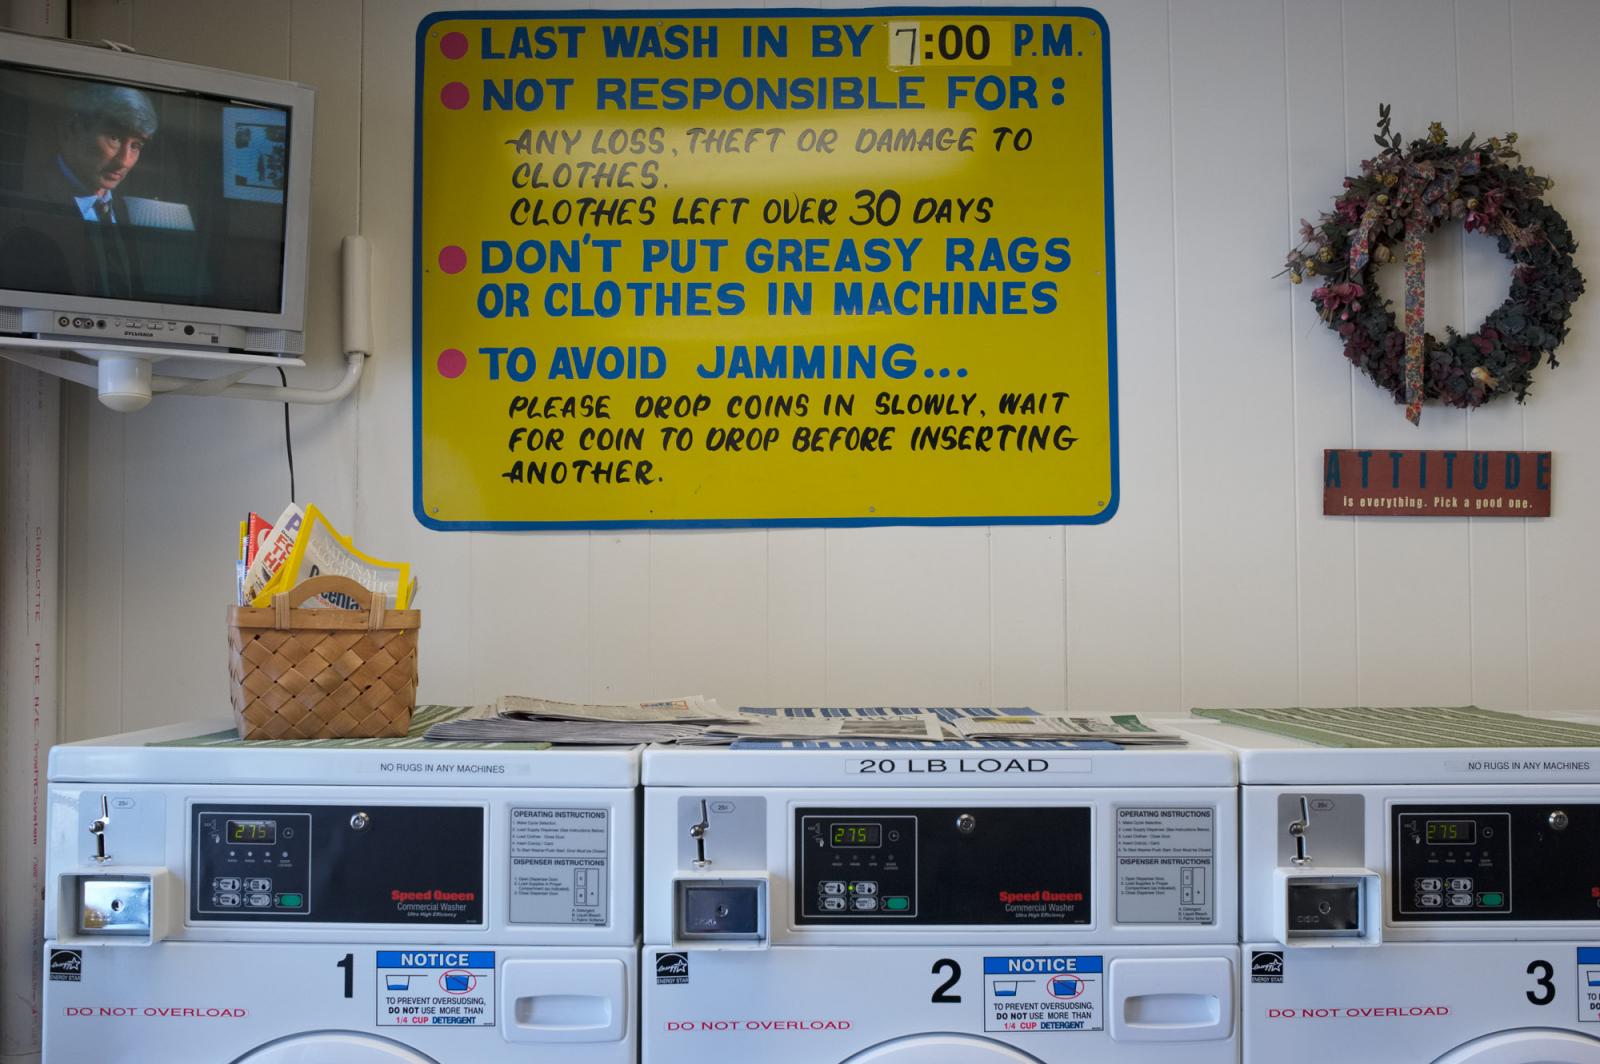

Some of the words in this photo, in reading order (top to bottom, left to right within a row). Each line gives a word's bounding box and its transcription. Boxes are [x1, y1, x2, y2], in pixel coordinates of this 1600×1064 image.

[481, 26, 585, 59] LAST
[603, 25, 717, 59] WASH
[743, 26, 787, 57] IN
[812, 25, 873, 57] BY
[1015, 24, 1082, 56] P.M.
[483, 79, 574, 111] NOT
[597, 76, 924, 110] RESPONSIBLE
[506, 128, 581, 154] ANY
[592, 128, 679, 158] LOSS,
[687, 126, 780, 154] THEFT
[798, 129, 837, 153] OR
[856, 127, 977, 153] DAMAGE
[993, 127, 1032, 151] TO
[512, 160, 669, 189] CLOTHES.
[510, 197, 656, 226] CLOTHES
[673, 198, 749, 224] LEFT
[763, 198, 837, 225] OVER
[849, 190, 901, 226] 30
[913, 197, 993, 223] DAYS
[482, 234, 621, 273] DON'T
[643, 240, 728, 273] PUT
[746, 238, 922, 273] GREASY
[946, 237, 1071, 272] RAGS
[477, 283, 529, 318] OR
[544, 281, 745, 317] CLOTHES
[768, 283, 812, 315] IN
[834, 281, 1057, 315] MACHINES
[479, 347, 536, 382] TO
[549, 346, 666, 379] AVOID
[697, 344, 967, 379] JAMMING...
[509, 395, 610, 418] PLEASE
[635, 395, 711, 419] DROP
[727, 394, 809, 419] COINS
[824, 394, 854, 416] IN
[876, 392, 986, 417] SLOWLY,
[999, 392, 1069, 414] WAIT
[509, 428, 564, 451] FOR
[579, 428, 644, 450] COIN
[661, 427, 693, 451] TO
[706, 428, 779, 451] DROP
[792, 427, 895, 452] BEFORE
[911, 425, 1080, 452] INSERTING
[502, 460, 664, 484] ANOTHER.
[1326, 451, 1549, 490] ATTITUDE
[1343, 496, 1354, 507] is
[1360, 496, 1427, 509] everything.
[1434, 496, 1458, 508] Pick
[1464, 498, 1470, 508] a
[1475, 496, 1502, 510] good
[1509, 498, 1533, 509] one.
[380, 763, 394, 772] NO
[396, 763, 423, 773] RUGS
[425, 764, 433, 773] IN
[436, 764, 455, 773] ANY
[456, 764, 505, 774] MACHINES
[859, 759, 895, 774] 20
[908, 759, 948, 773] LB
[959, 758, 1050, 773] LOAD
[1468, 761, 1482, 770] NO
[1483, 761, 1510, 770] RUGS
[1511, 761, 1521, 770] IN
[1522, 761, 1541, 770] ANY
[1542, 761, 1590, 770] MACHINES
[514, 810, 553, 818] OPERATING
[555, 811, 606, 819] INSTRUCTIONS
[1120, 810, 1159, 818] OPERATING
[1160, 810, 1211, 818] INSTRUCTIONS
[391, 889, 432, 902] Speed
[434, 890, 475, 901] Queen
[999, 891, 1040, 903] Speed
[1042, 891, 1083, 902] Queen
[397, 902, 439, 911] Commercial
[440, 902, 467, 911] Washer
[1005, 903, 1047, 912] Commercial
[1048, 903, 1074, 912] Washer
[401, 953, 469, 966] NOTICE
[1008, 958, 1077, 972] NOTICE
[336, 953, 354, 999] 1
[931, 958, 962, 1004] 2
[1526, 960, 1556, 1006] 3
[386, 997, 395, 1005] TO
[397, 997, 430, 1005] PREVENT
[432, 997, 486, 1006] OVERSUDSING,
[993, 1003, 1003, 1011] TO
[1005, 1002, 1039, 1010] PREVENT
[1040, 1002, 1094, 1011] OVERSUDSING,
[66, 1007, 93, 1017] DO
[99, 1007, 138, 1017] NOT
[143, 1007, 246, 1018] OVERLOAD
[996, 1012, 1008, 1020] DO
[1010, 1012, 1027, 1020] NOT
[1029, 1012, 1044, 1020] USE
[1269, 1008, 1296, 1018] DO
[1302, 1008, 1341, 1018] NOT
[1346, 1006, 1449, 1017] OVERLOAD
[396, 1016, 408, 1024] 1/4
[412, 1016, 429, 1024] CUP
[432, 1016, 476, 1024] DETERGENT
[667, 1021, 695, 1031] DO
[701, 1021, 739, 1031] NOT
[746, 1020, 851, 1030] OVERLOAD
[1004, 1022, 1016, 1030] 1/4
[1020, 1022, 1037, 1030] CUP
[1041, 1021, 1085, 1029] DETERGENT
